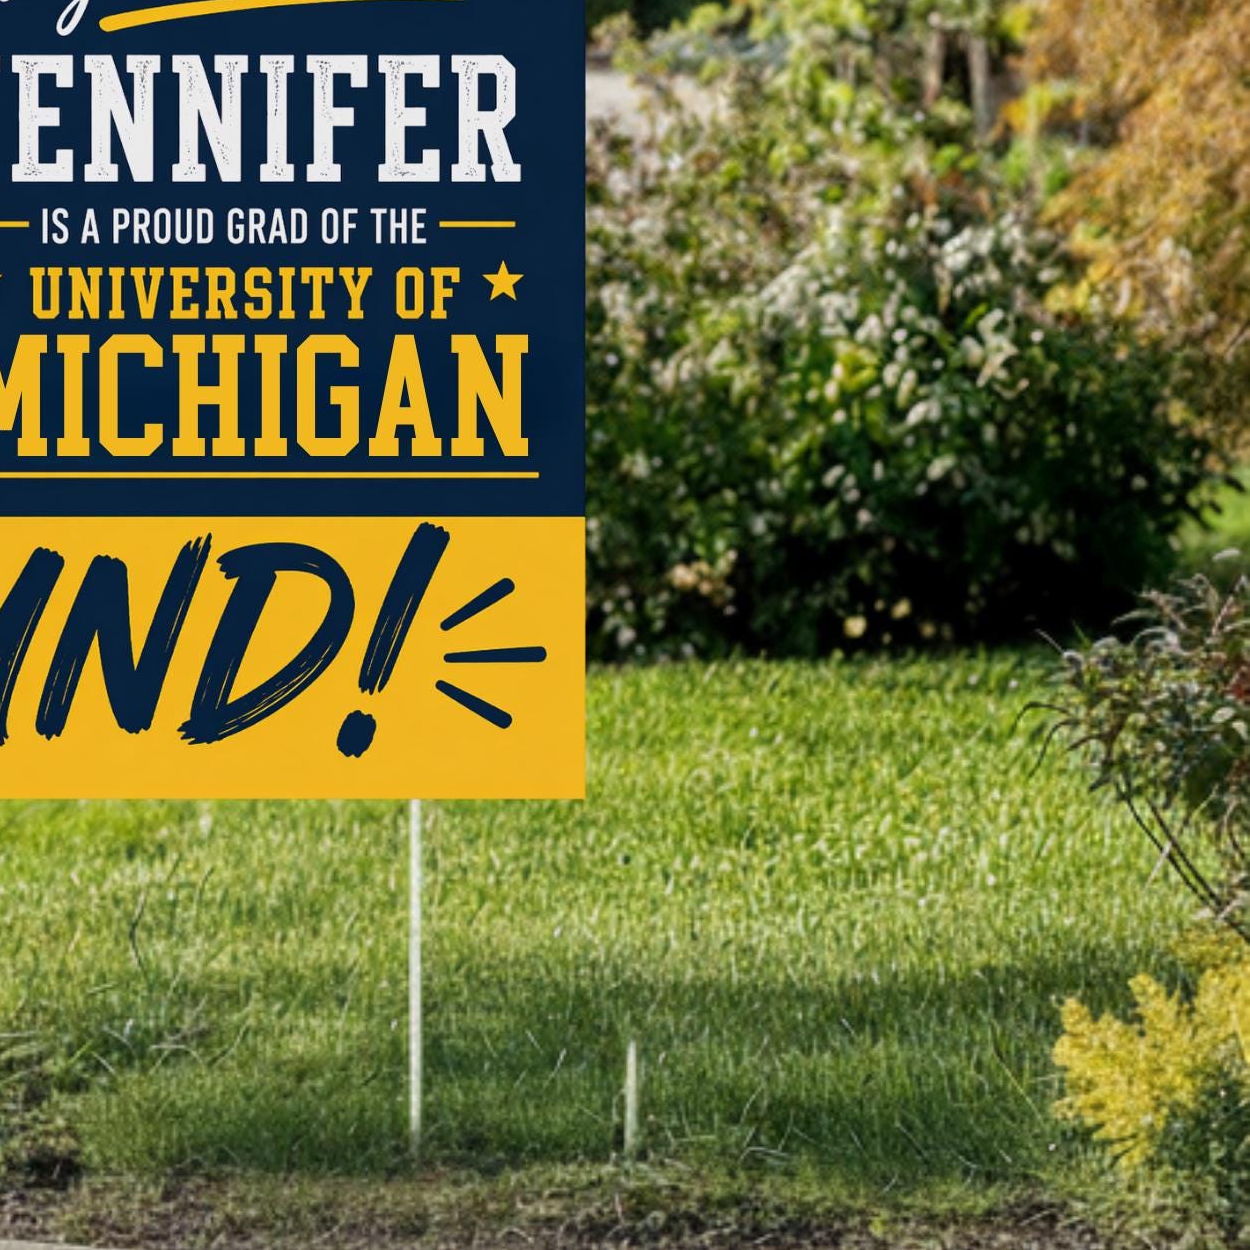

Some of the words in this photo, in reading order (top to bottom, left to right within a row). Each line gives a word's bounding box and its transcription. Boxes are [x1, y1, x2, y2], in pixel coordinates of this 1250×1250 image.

[42, 207, 69, 245] IS
[80, 207, 100, 245] A
[112, 207, 214, 245] PROUD
[227, 207, 308, 245] GRAD
[321, 207, 358, 245] OF
[370, 207, 427, 245] THE
[30, 266, 372, 320] UNIVERSITY
[396, 266, 460, 320] OF
